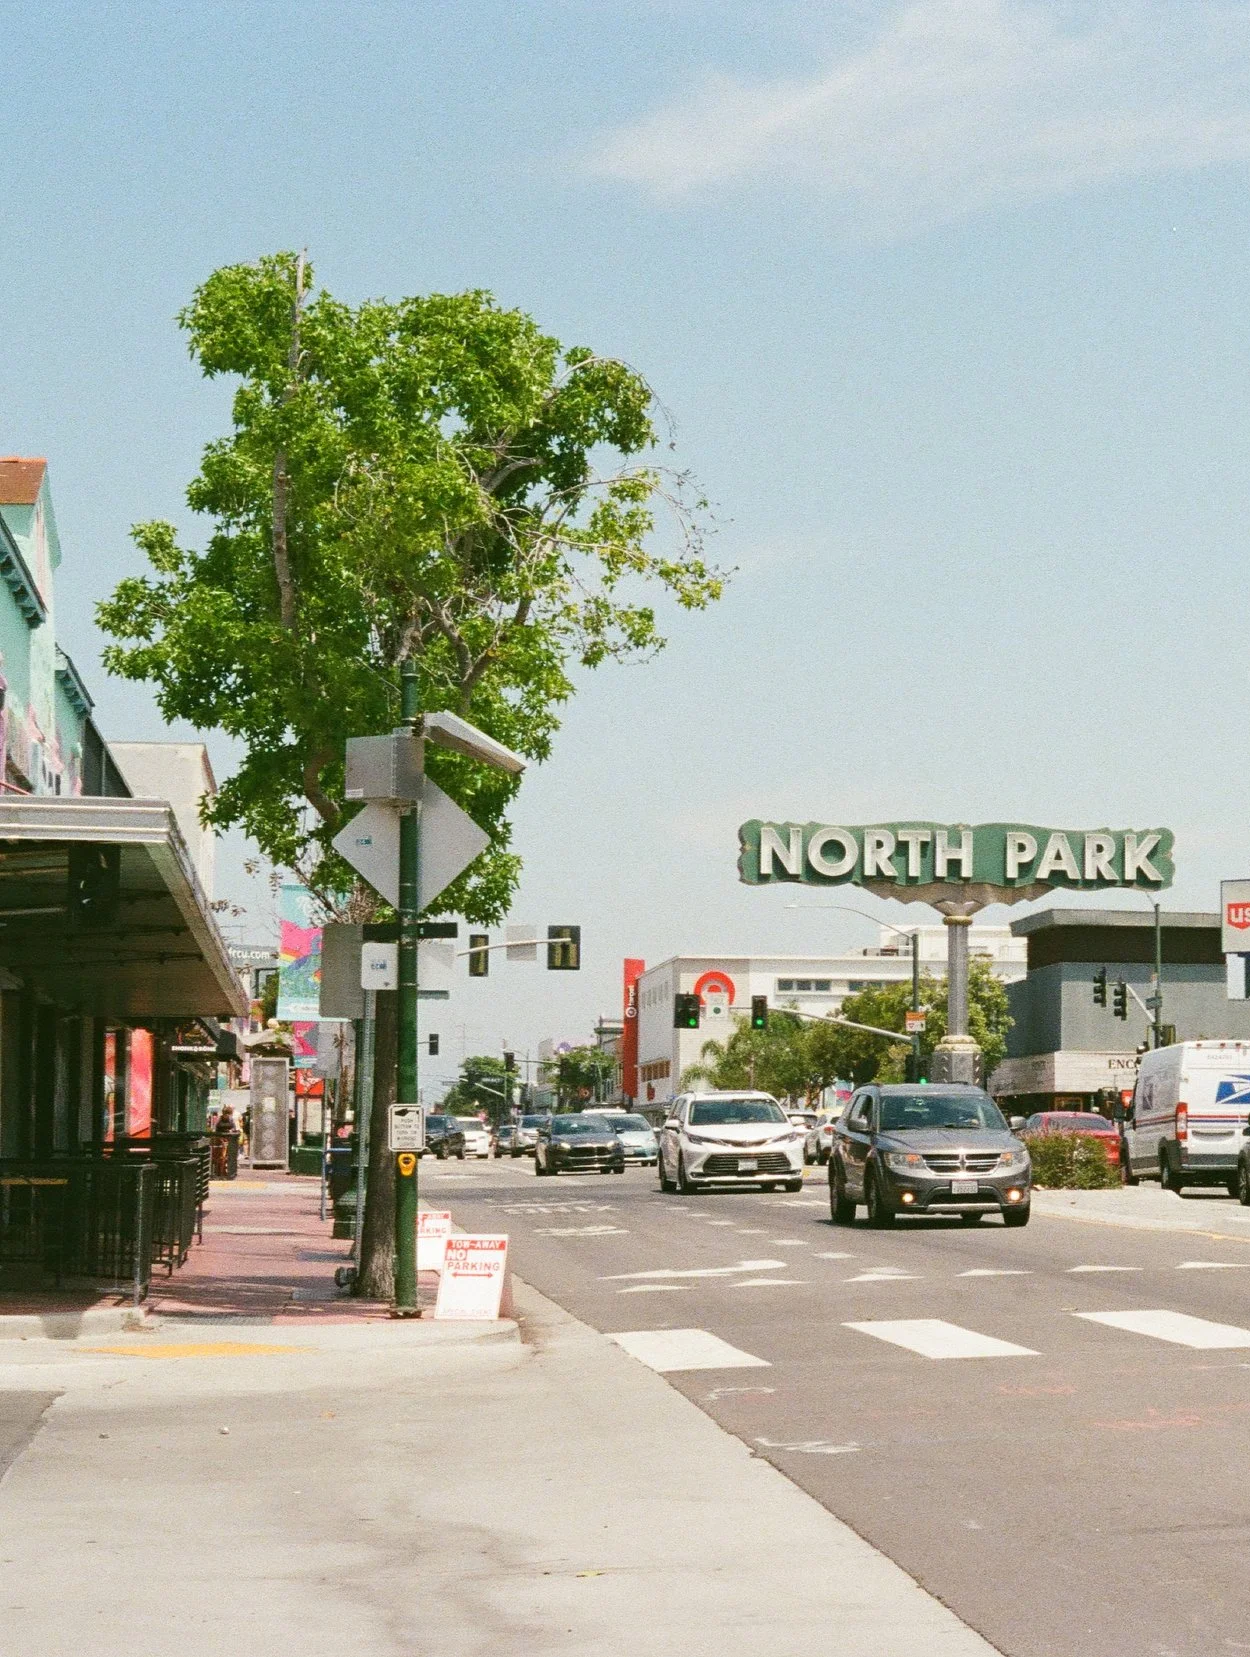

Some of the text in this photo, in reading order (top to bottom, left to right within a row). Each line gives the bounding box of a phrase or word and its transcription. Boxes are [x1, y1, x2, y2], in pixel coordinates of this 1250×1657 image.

[759, 827, 1165, 881] NORTH PARK
[451, 1240, 500, 1249] TOW-AWAY
[446, 1250, 466, 1260] NO
[447, 1261, 500, 1272] PARKING
